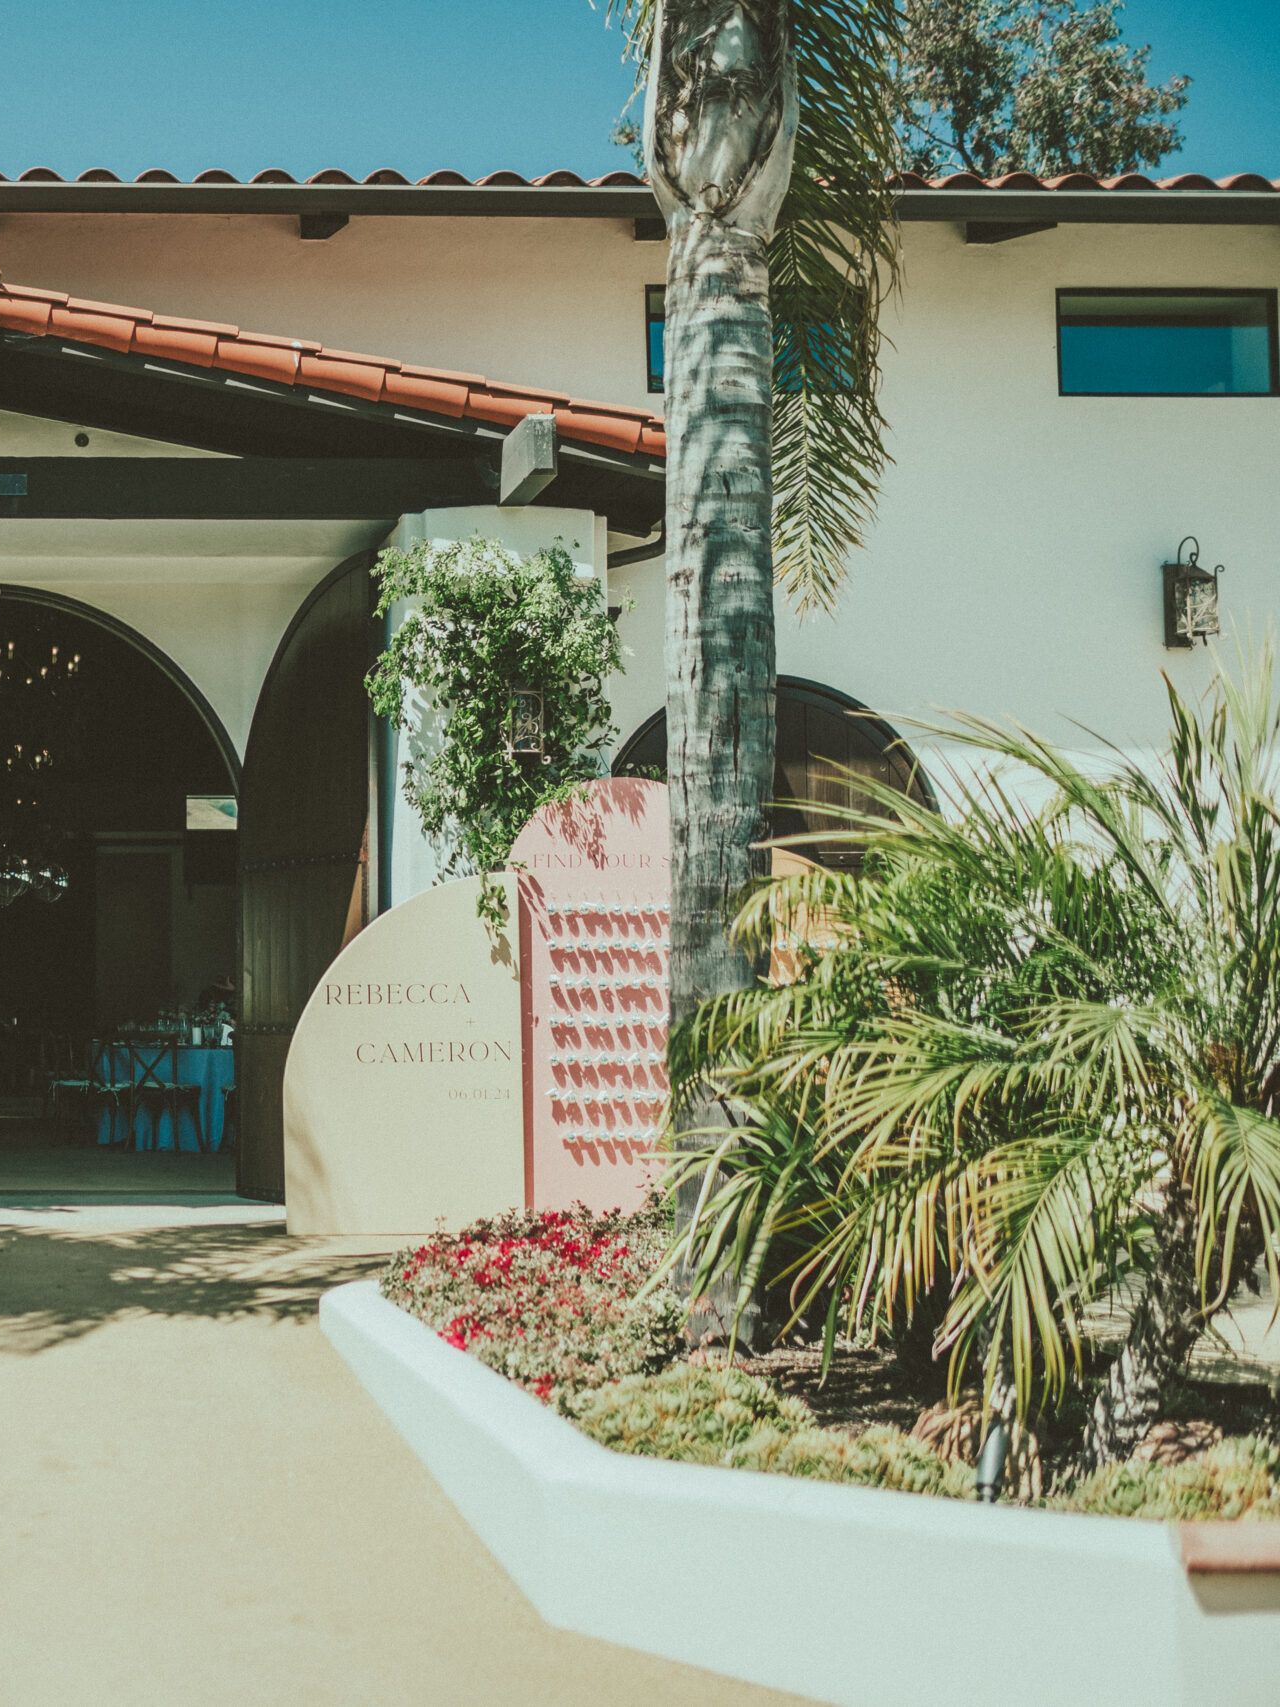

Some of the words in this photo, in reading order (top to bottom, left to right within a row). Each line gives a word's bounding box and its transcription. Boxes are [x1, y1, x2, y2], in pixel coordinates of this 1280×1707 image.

[532, 853, 582, 869] FIND
[325, 983, 472, 1006] REBECCA
[356, 1040, 512, 1065] CAMERON
